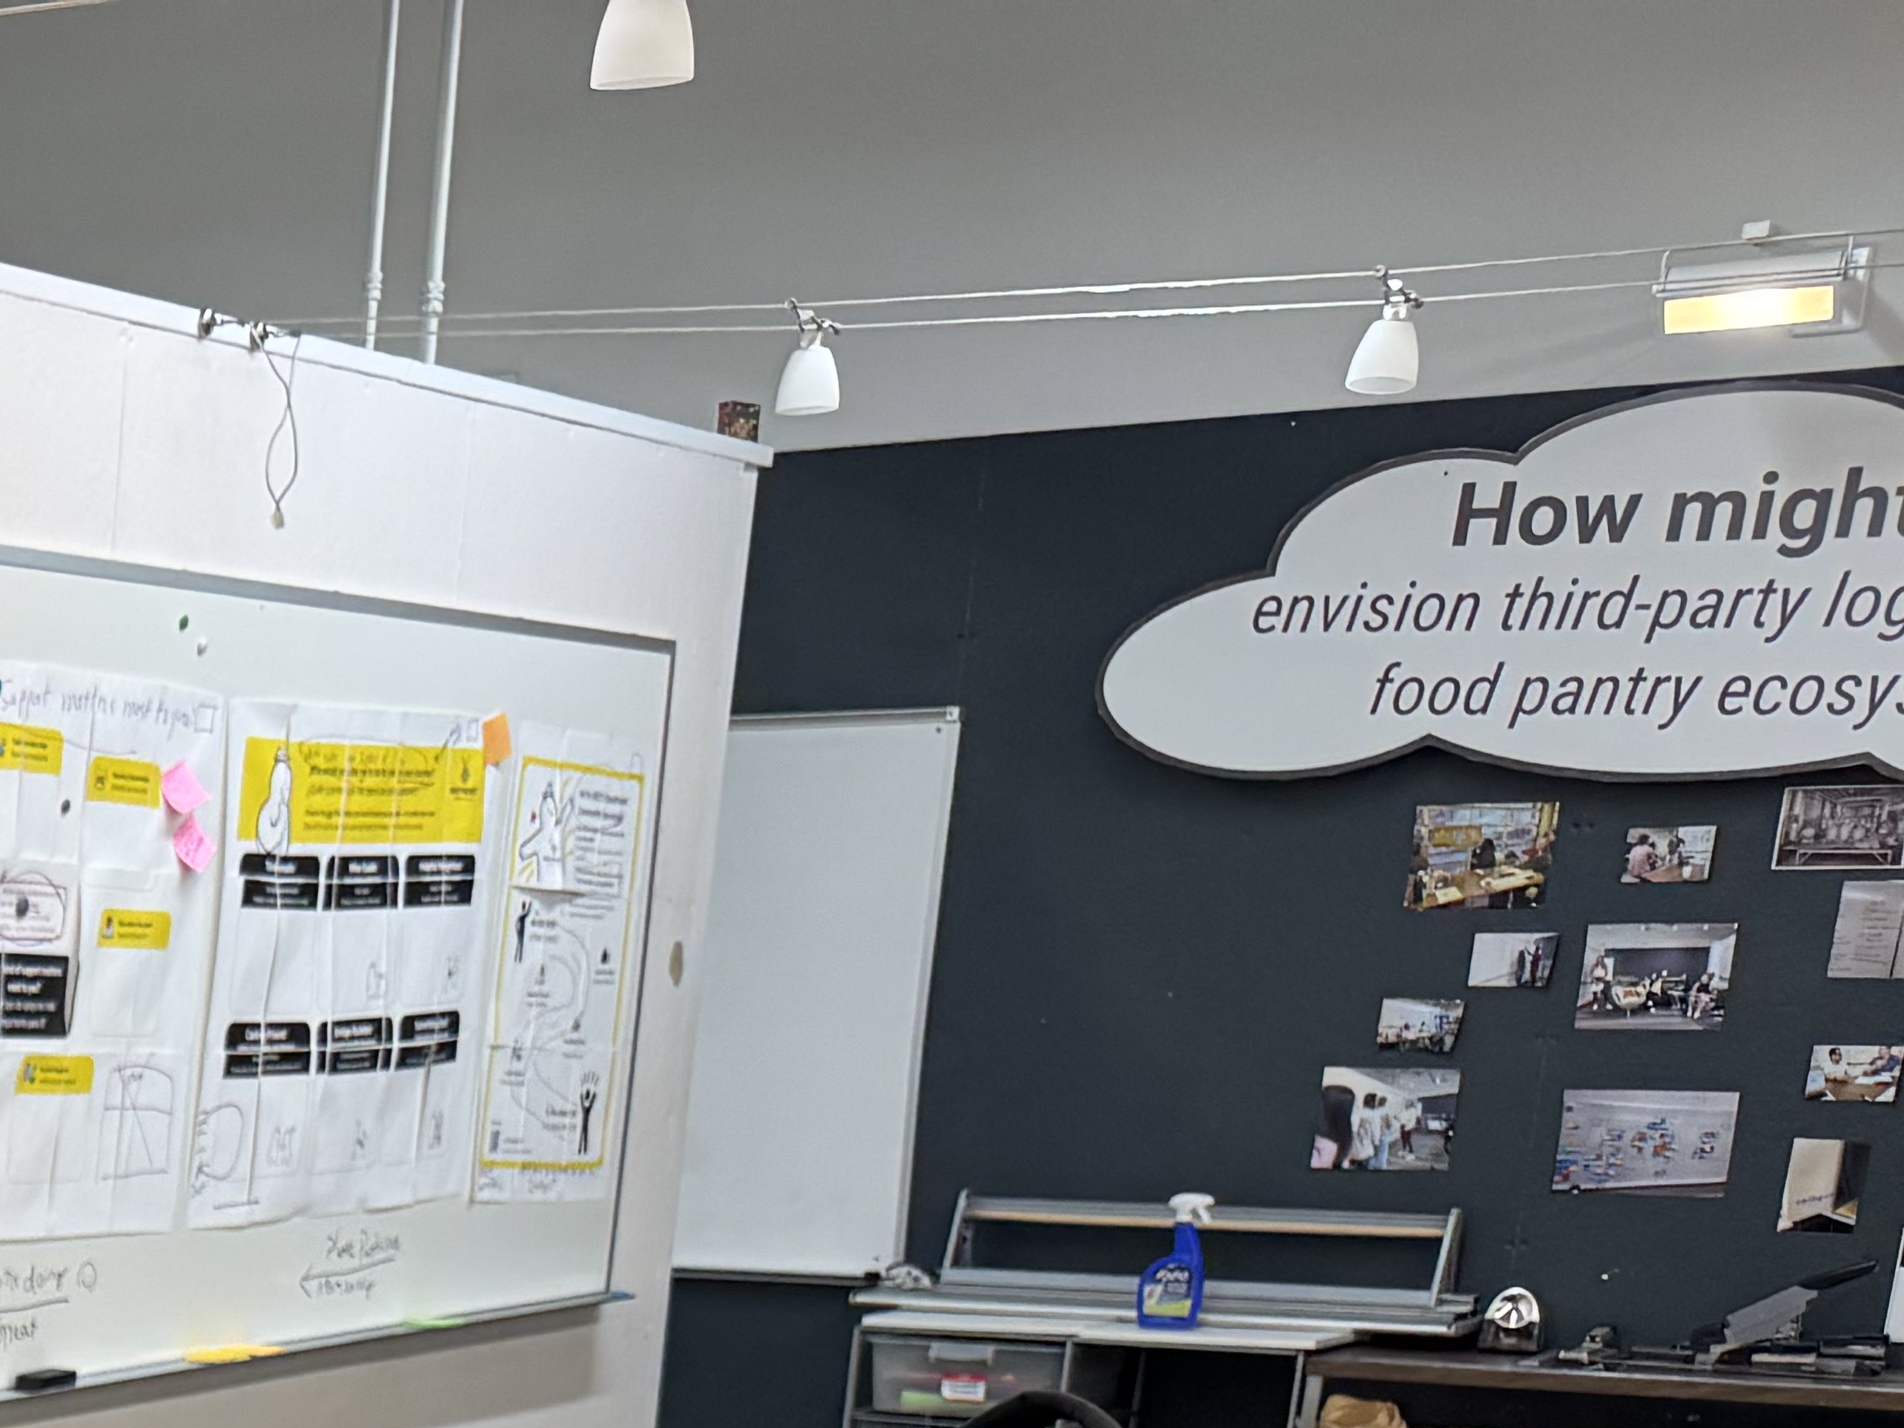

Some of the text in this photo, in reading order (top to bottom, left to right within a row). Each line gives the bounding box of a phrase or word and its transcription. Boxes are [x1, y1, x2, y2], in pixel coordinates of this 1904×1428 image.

[1451, 479, 1643, 548] How
[1251, 579, 1484, 635] envision
[1499, 574, 1812, 643] third-party
[1369, 661, 1904, 732] food pantry ecosy
